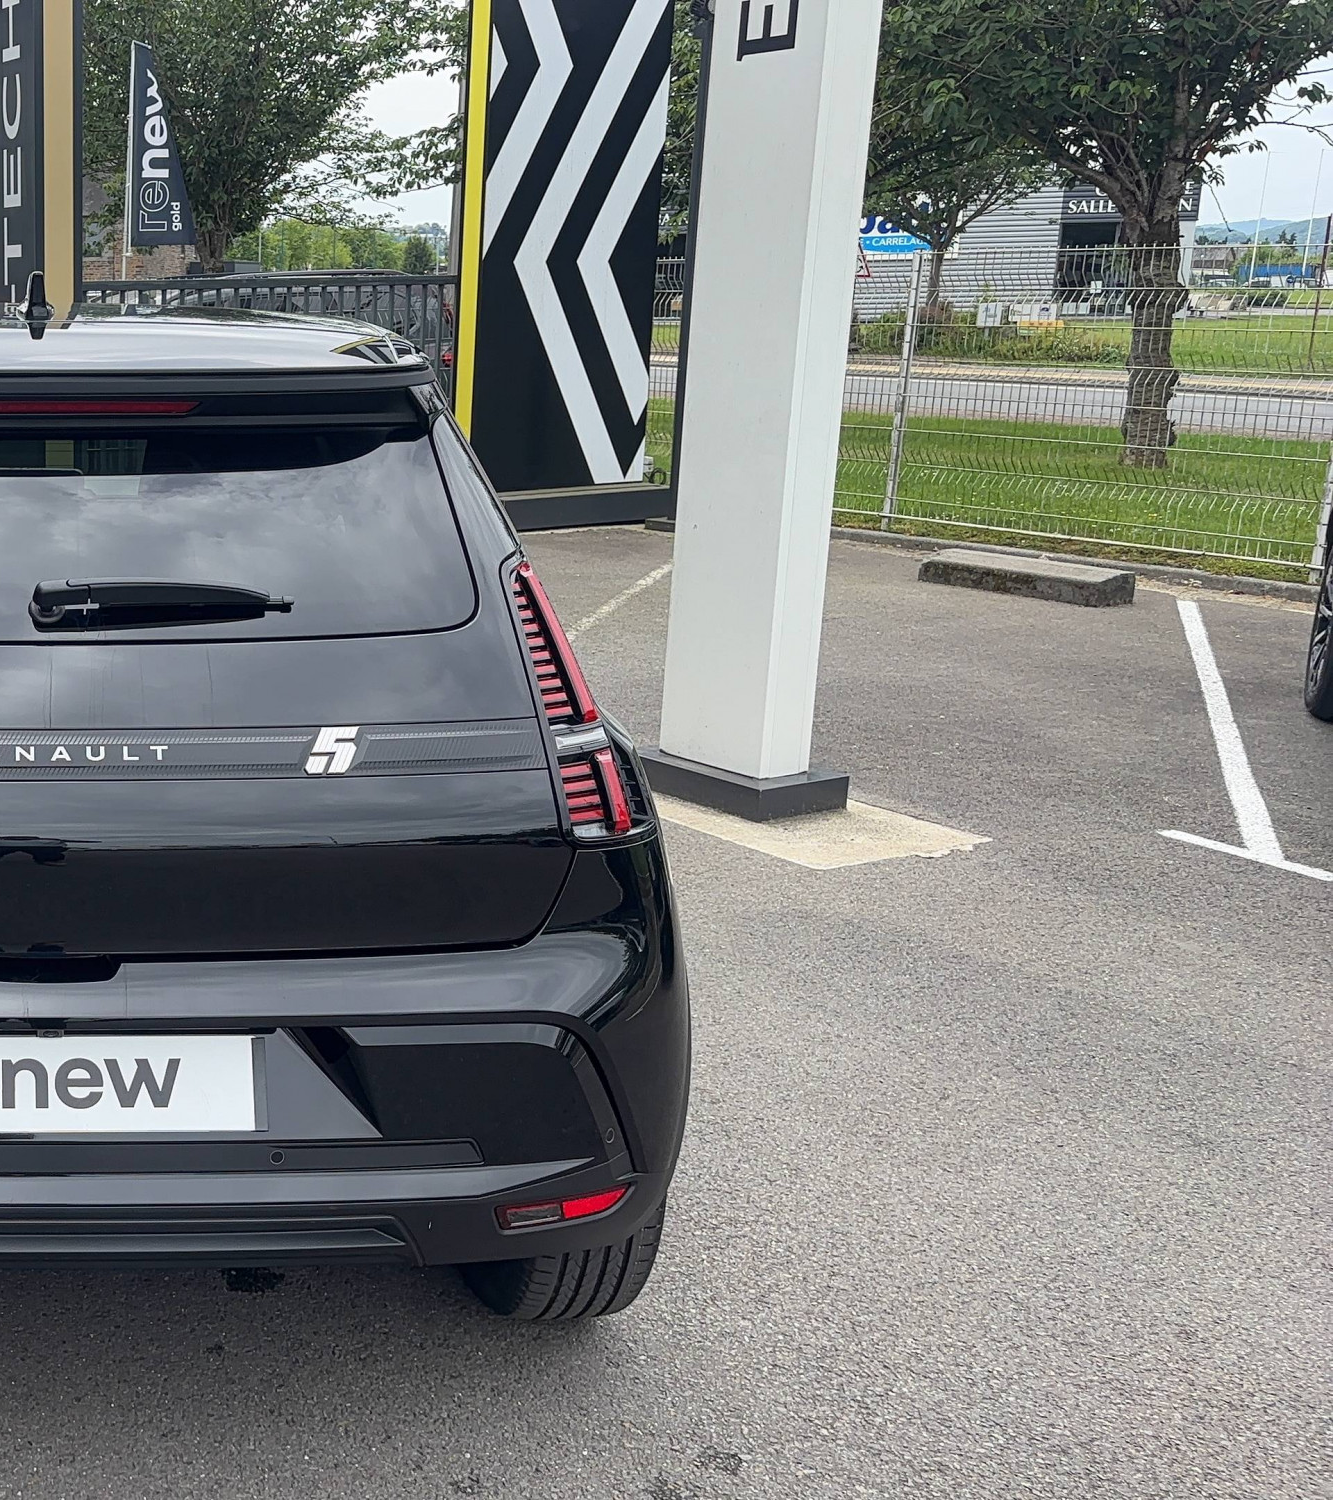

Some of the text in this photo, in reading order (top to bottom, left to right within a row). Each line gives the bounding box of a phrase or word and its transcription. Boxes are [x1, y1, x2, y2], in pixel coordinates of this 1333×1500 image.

[138, 68, 170, 232] renew
[171, 202, 183, 232] gold
[303, 726, 361, 776] 5
